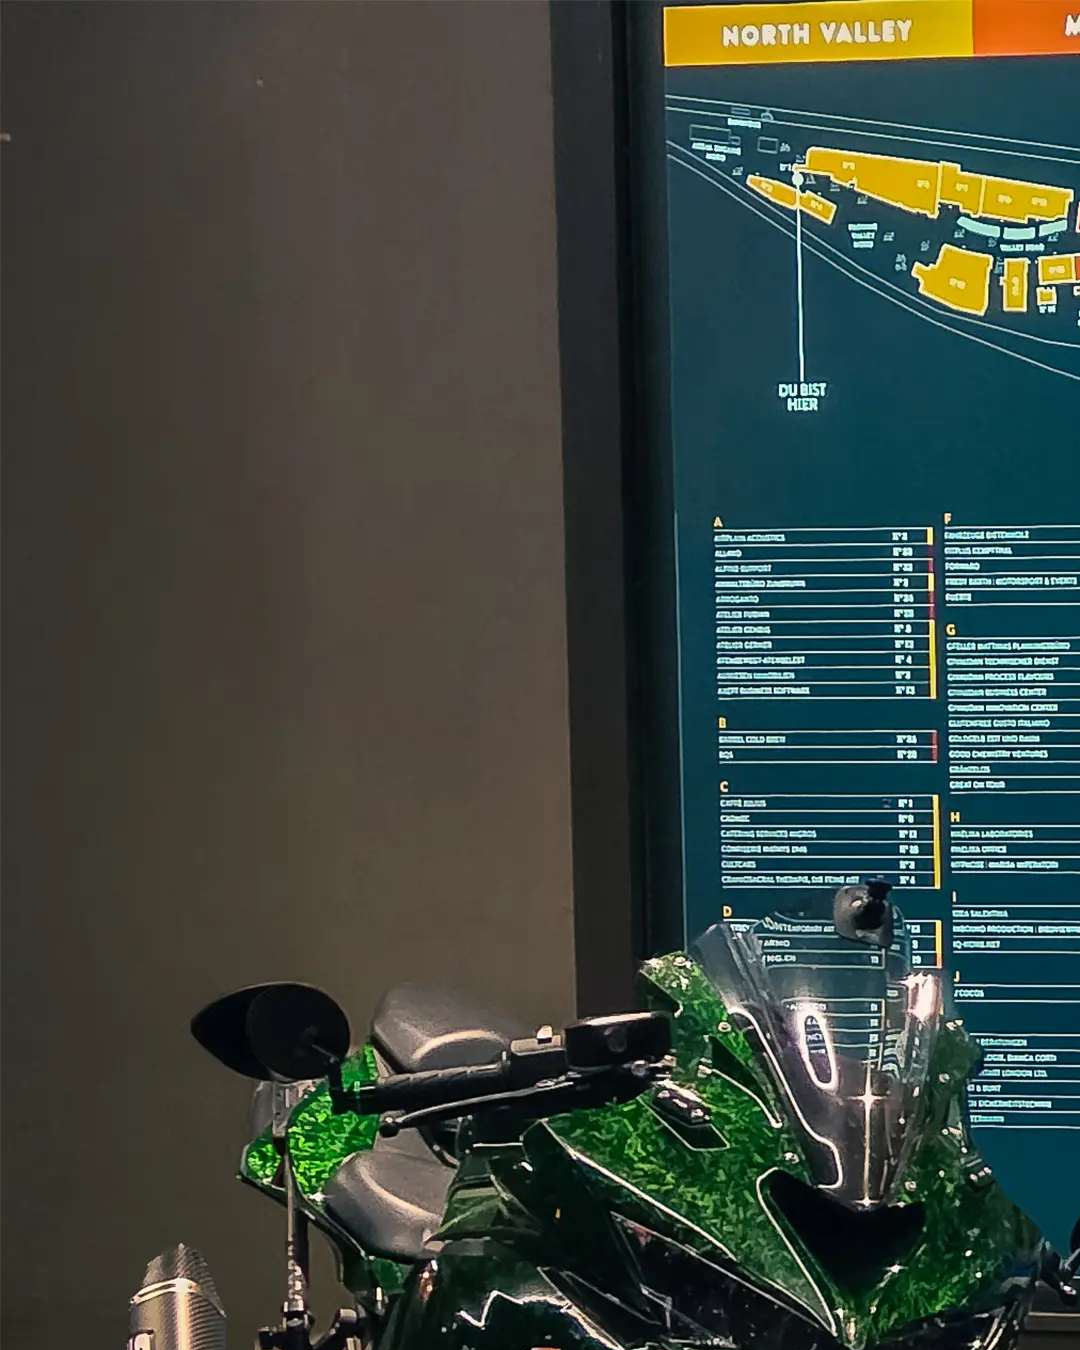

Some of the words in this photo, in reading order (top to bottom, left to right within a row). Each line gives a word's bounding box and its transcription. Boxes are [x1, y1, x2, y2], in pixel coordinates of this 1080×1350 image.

[723, 23, 809, 47] NORTH
[821, 20, 911, 44] VALLEY
[779, 383, 798, 398] DU
[799, 382, 827, 397] BIST
[787, 397, 819, 411] HIER
[713, 516, 724, 528] A
[943, 512, 952, 525] F
[945, 623, 956, 636] G
[719, 780, 729, 793] C
[950, 811, 961, 823] H
[723, 906, 732, 918] D
[953, 970, 960, 983] J
